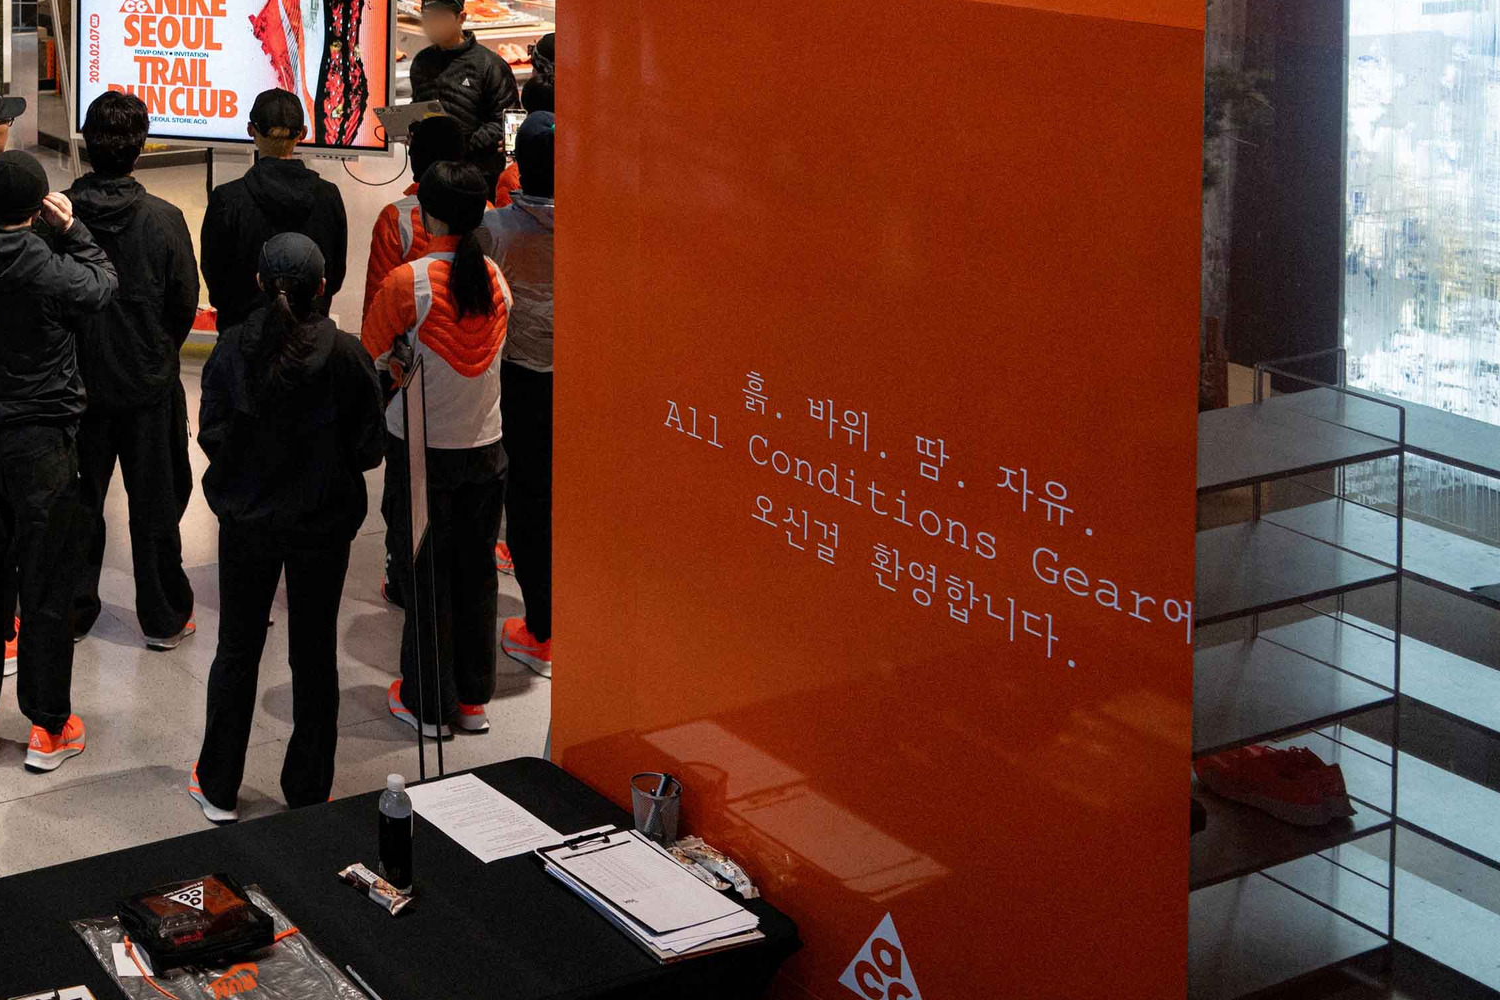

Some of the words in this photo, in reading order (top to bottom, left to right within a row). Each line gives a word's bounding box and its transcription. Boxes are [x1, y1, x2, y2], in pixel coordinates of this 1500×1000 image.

[123, 13, 223, 51] SEOUL
[89, 29, 100, 83] 2026.02.07
[133, 55, 212, 88] TRAIL
[169, 87, 238, 118] CLUB
[742, 370, 783, 421] 흙.
[807, 398, 887, 459] 바위.
[915, 435, 965, 489] 땀.
[996, 465, 1094, 537] 자유.
[664, 400, 725, 449] All
[749, 434, 997, 560] Conditions
[751, 495, 840, 567] 오신걸
[872, 542, 1076, 668] 환영합니다.
[209, 974, 258, 999] RUN
